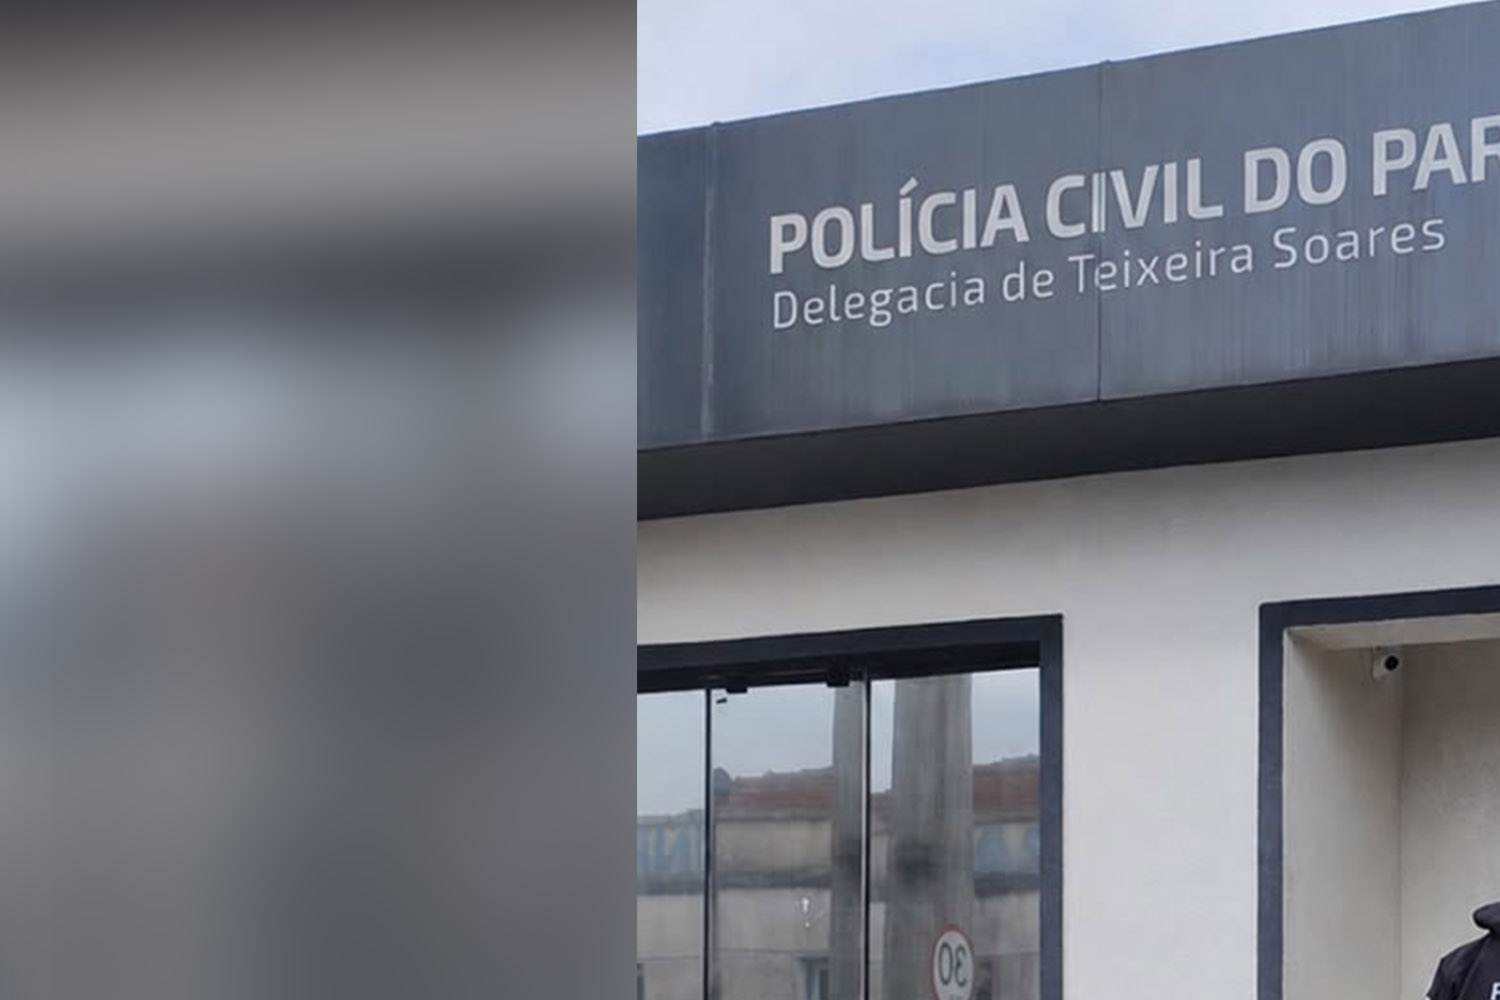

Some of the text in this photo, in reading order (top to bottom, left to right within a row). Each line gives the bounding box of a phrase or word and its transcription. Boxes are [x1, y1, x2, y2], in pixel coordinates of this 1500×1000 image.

[770, 177, 1029, 274] POLÍCIA
[1046, 158, 1223, 238] CIVIL
[1244, 138, 1347, 215] DO
[773, 218, 1446, 329] Delegacia de Teixeira Soares
